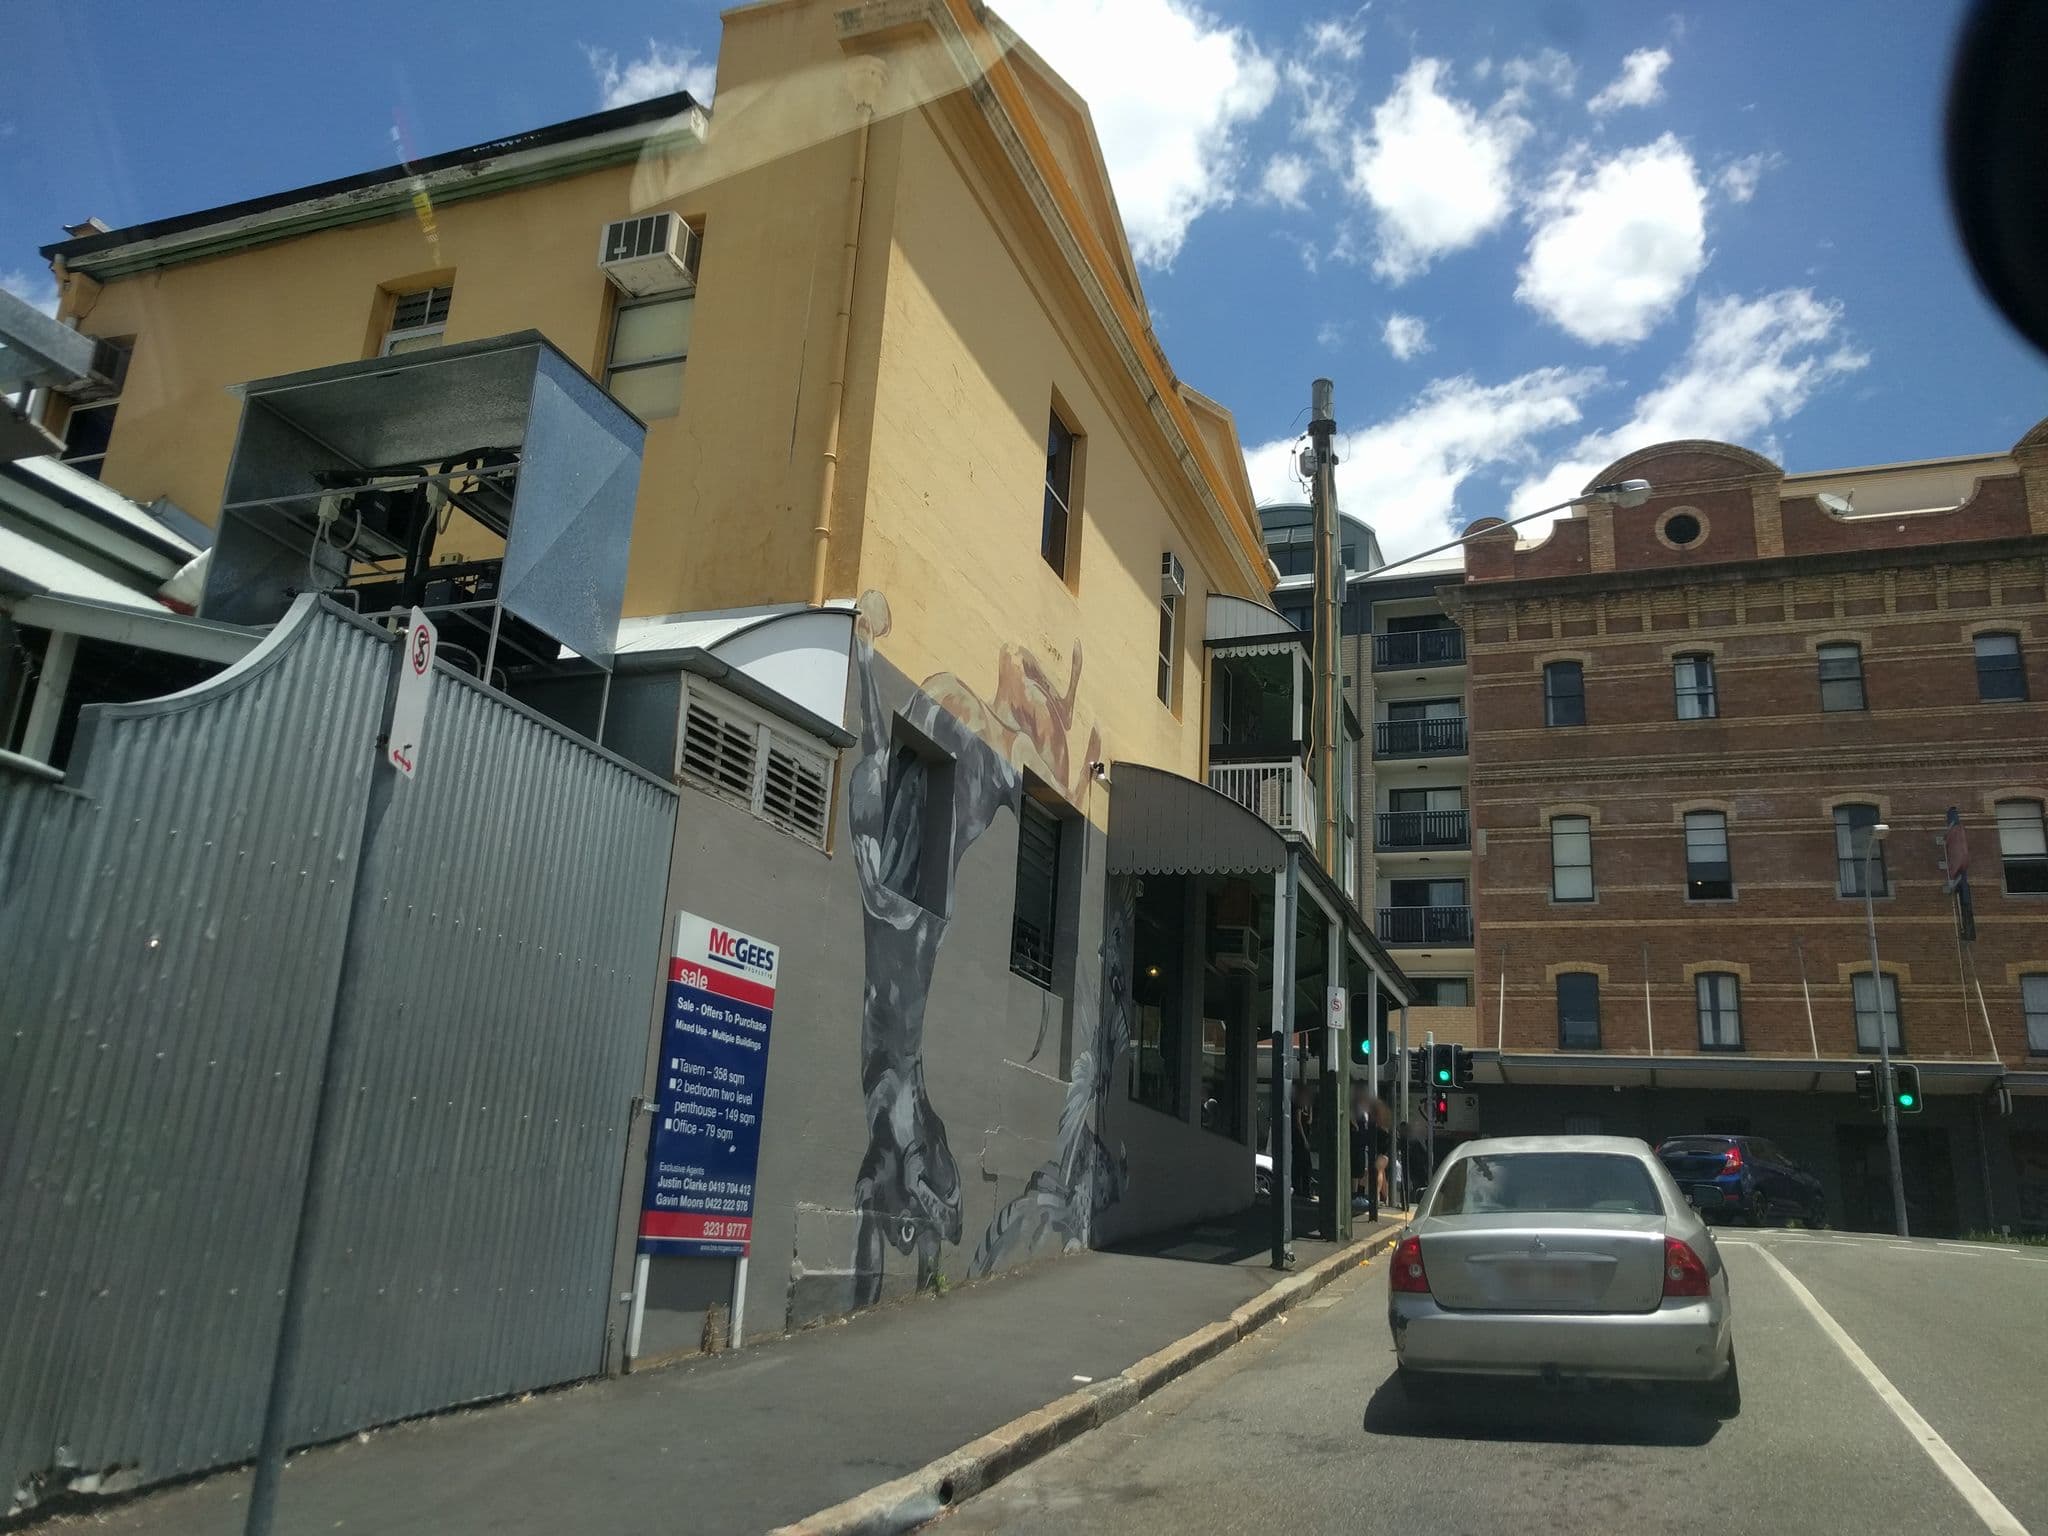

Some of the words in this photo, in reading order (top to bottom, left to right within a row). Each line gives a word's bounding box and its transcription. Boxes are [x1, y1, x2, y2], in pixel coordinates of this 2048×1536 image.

[708, 927, 774, 972] McGEES
[680, 968, 708, 990] sale
[677, 996, 694, 1013] Sale
[701, 1004, 723, 1020] Offers
[724, 1010, 733, 1023] To
[734, 1014, 767, 1032] Purchase
[675, 1019, 695, 1033] Mixed
[696, 1025, 708, 1036] Use
[712, 1029, 734, 1044] Multiple
[735, 1035, 762, 1051] Buildings
[679, 1058, 705, 1076] Tavern
[713, 1066, 728, 1081] 358
[729, 1072, 745, 1085] sqm
[676, 1078, 683, 1092] 2
[684, 1080, 719, 1098] bedroom
[721, 1088, 735, 1101] two
[736, 1092, 753, 1105] level
[674, 1099, 717, 1118] penthouse
[725, 1108, 739, 1122] 149
[740, 1112, 755, 1125] sqm
[673, 1119, 697, 1135] Office
[706, 1124, 715, 1137] 79
[716, 1129, 734, 1141] sqm
[659, 1162, 686, 1173] Exclusive
[686, 1165, 705, 1176] Agents
[658, 1175, 682, 1189] Justin
[683, 1178, 707, 1190] Clarke
[708, 1181, 725, 1193] 0419
[656, 1193, 678, 1206] Gavin
[680, 1195, 704, 1208] Moore
[705, 1197, 721, 1209] 0422
[722, 1199, 735, 1210] 222
[703, 1221, 724, 1236] 3231
[727, 1223, 747, 1237] 9777
